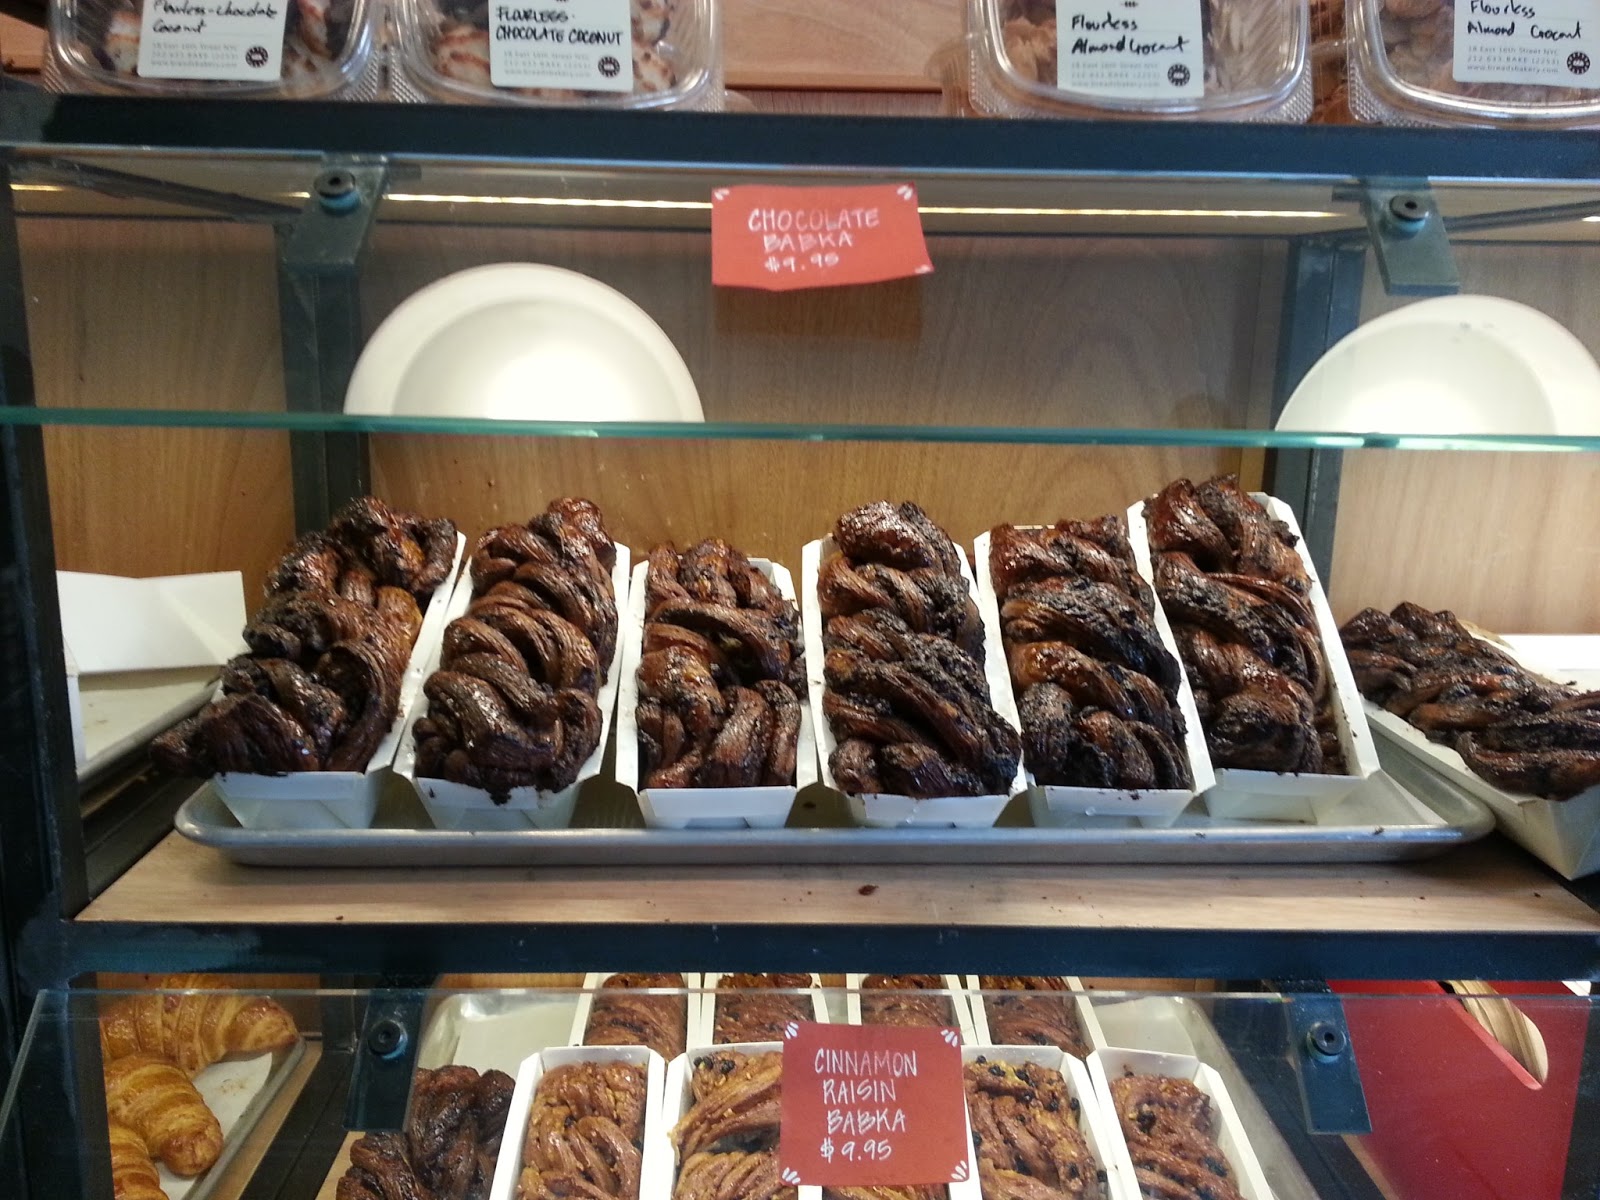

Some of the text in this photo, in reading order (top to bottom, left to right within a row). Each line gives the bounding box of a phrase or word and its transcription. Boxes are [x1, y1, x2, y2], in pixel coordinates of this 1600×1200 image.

[1471, 0, 1535, 18] Flourless
[1072, 11, 1138, 30] Flourless
[1467, 21, 1515, 36] Almond
[496, 25, 624, 45] CHOCOLATE COCONUT
[1072, 35, 1126, 54] Almond
[748, 208, 880, 232] CHOCOLATE
[763, 230, 853, 253] BABKA
[814, 1048, 917, 1077] CINNAMON
[822, 1079, 897, 1105] RAISIN
[827, 1108, 906, 1136] BABKA
